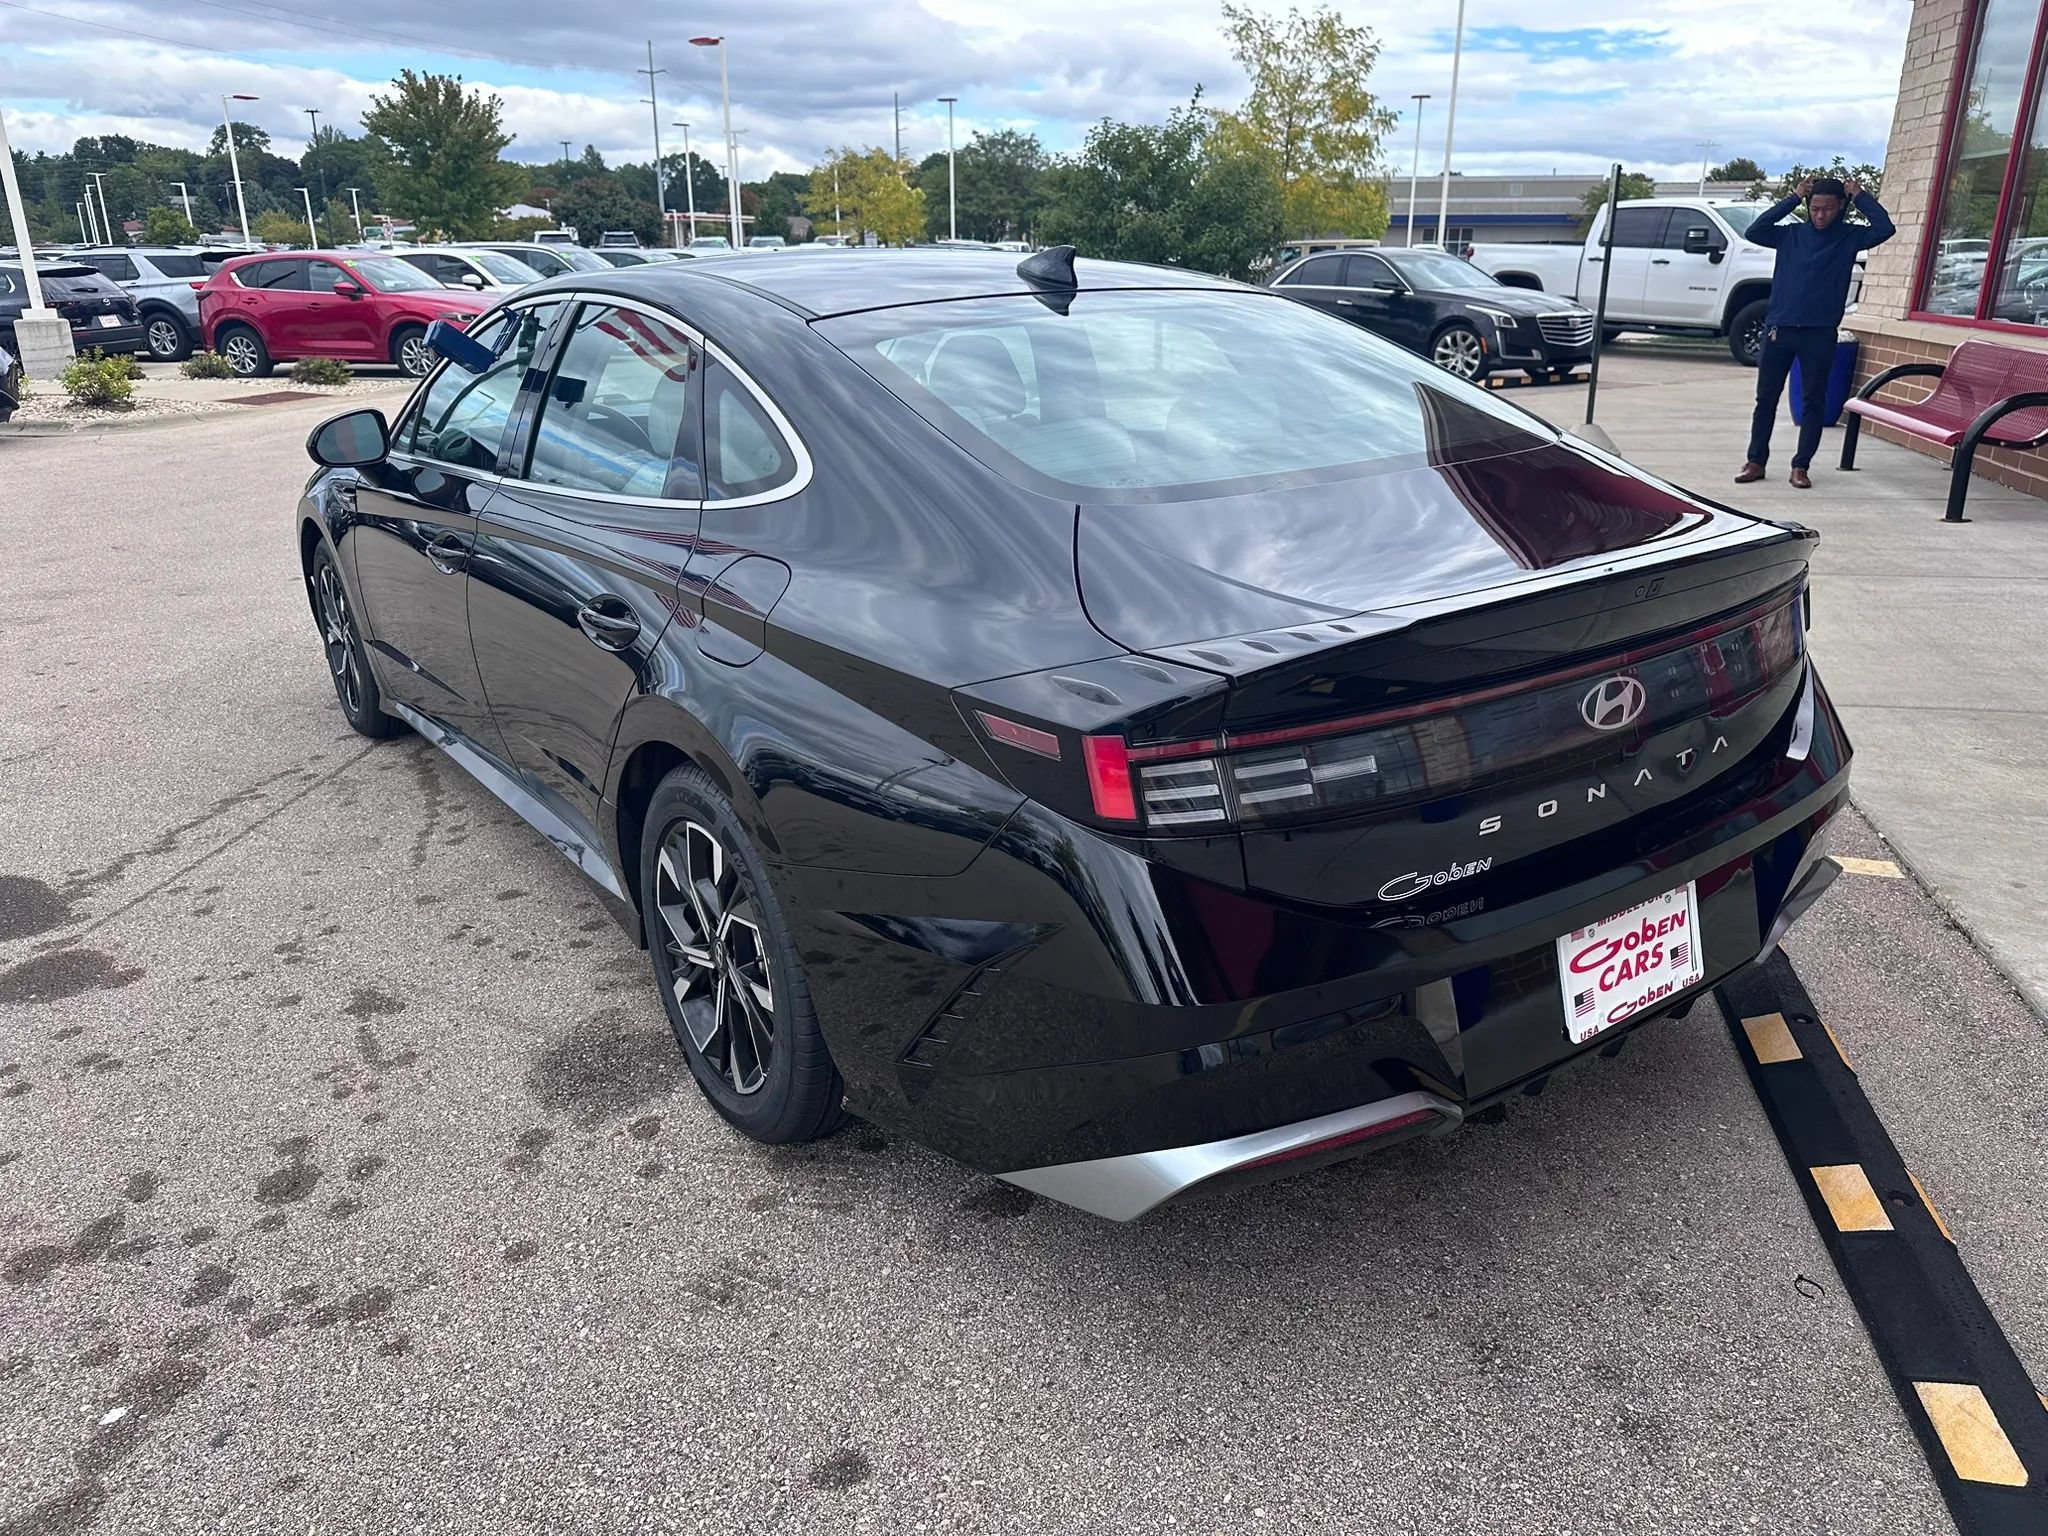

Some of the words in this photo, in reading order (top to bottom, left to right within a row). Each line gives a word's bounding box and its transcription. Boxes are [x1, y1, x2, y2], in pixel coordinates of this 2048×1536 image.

[1479, 736, 1728, 836] SONATA
[1599, 942, 1664, 992] CARS
[1580, 1025, 1599, 1041] USA
[1682, 973, 1700, 988] USA
